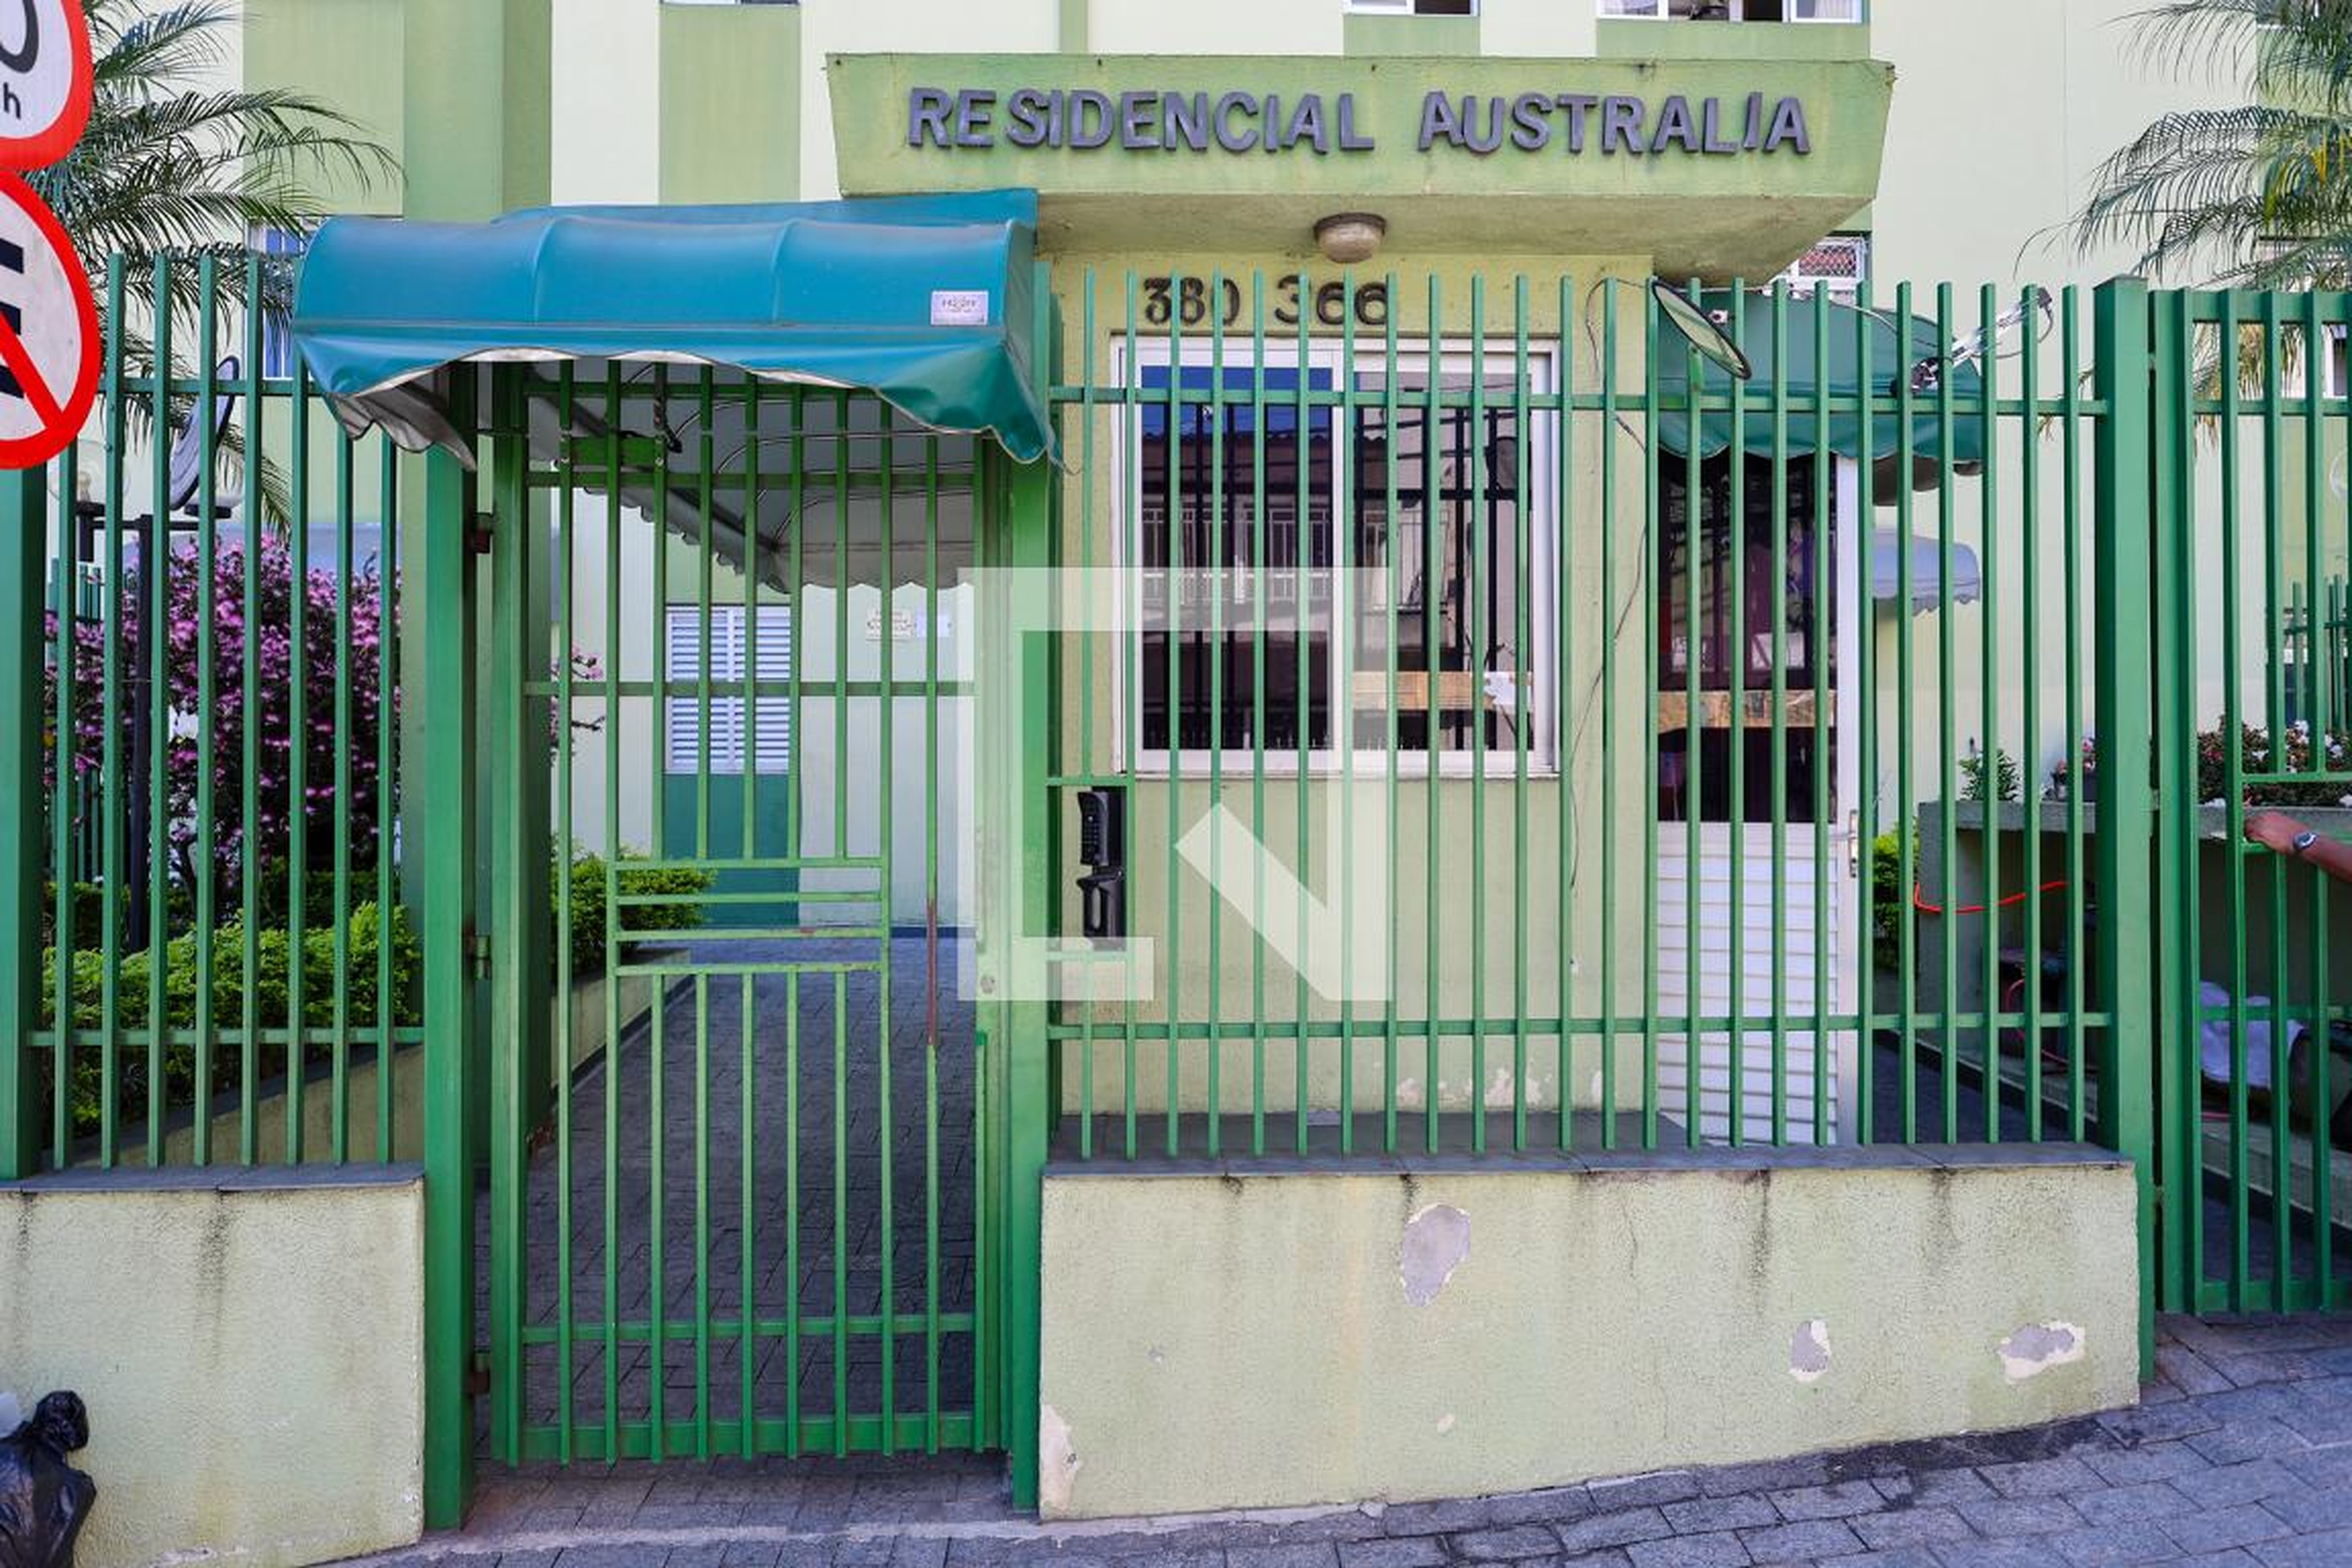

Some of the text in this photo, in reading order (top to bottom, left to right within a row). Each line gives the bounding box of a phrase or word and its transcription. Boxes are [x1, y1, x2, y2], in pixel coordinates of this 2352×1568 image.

[908, 87, 1811, 155] RESIDENCIAL AUSTRALIA
[1274, 274, 1389, 325] 366
